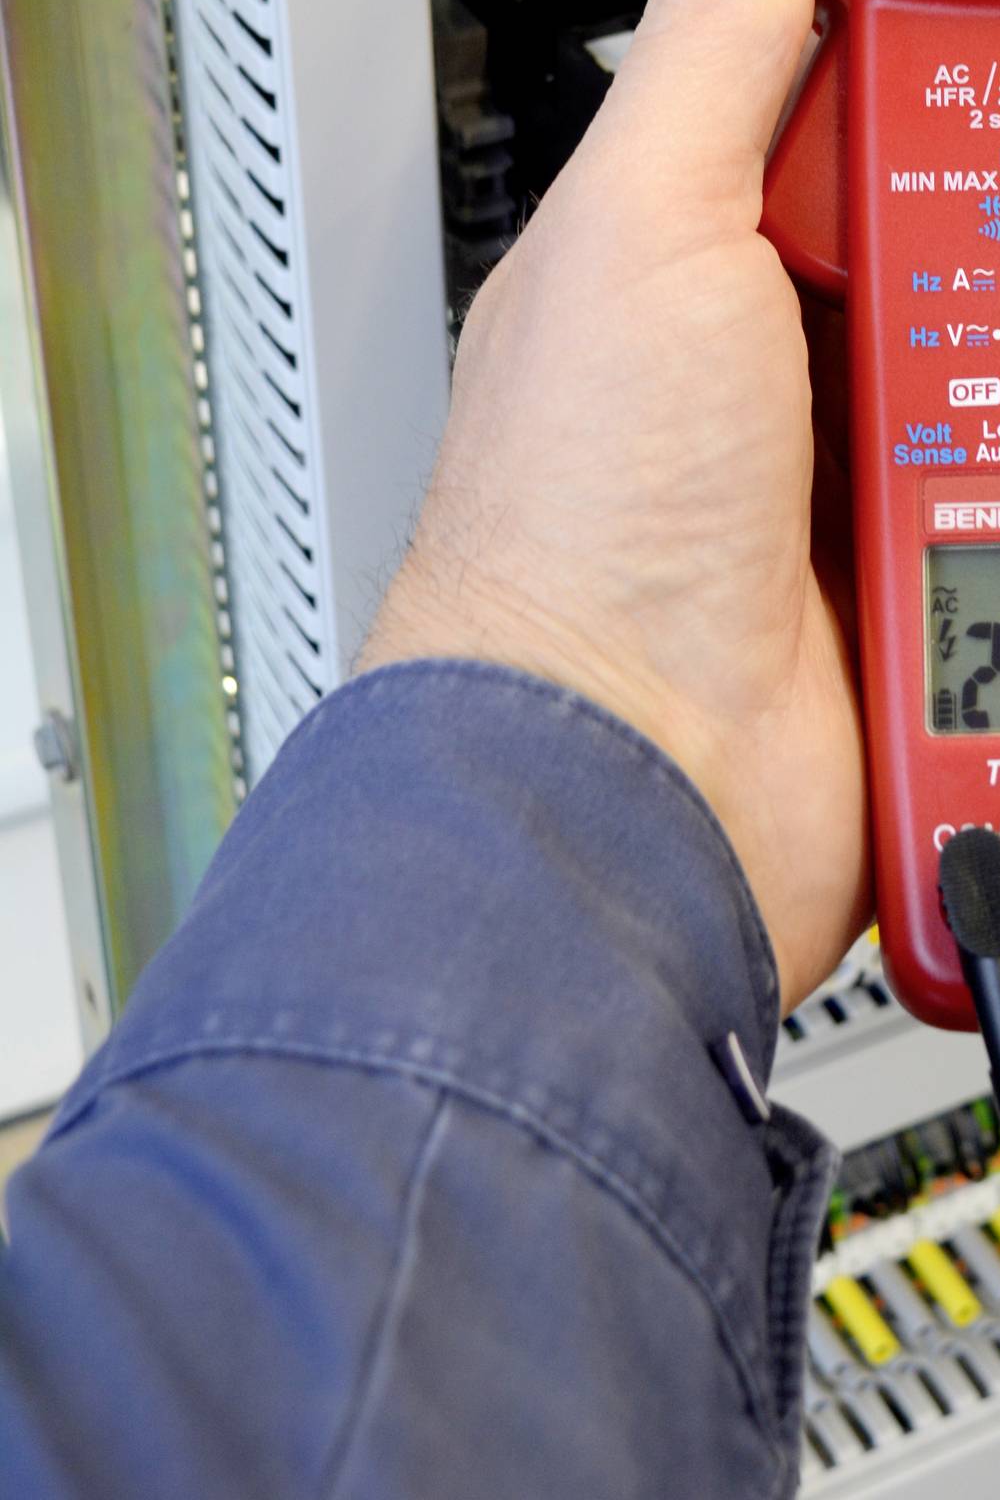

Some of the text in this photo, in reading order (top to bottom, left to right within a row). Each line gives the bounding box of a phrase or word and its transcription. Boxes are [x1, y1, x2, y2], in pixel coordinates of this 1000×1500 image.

[934, 64, 969, 84] AC
[925, 87, 976, 107] HFR
[969, 109, 983, 129] 2
[891, 171, 935, 191] MIN
[943, 170, 998, 191] MAX
[912, 271, 942, 292] Hz
[910, 326, 940, 347] Hz
[953, 382, 998, 401] OFF
[906, 423, 952, 445] Volt
[894, 445, 967, 465] Sense
[932, 597, 958, 614] AC
